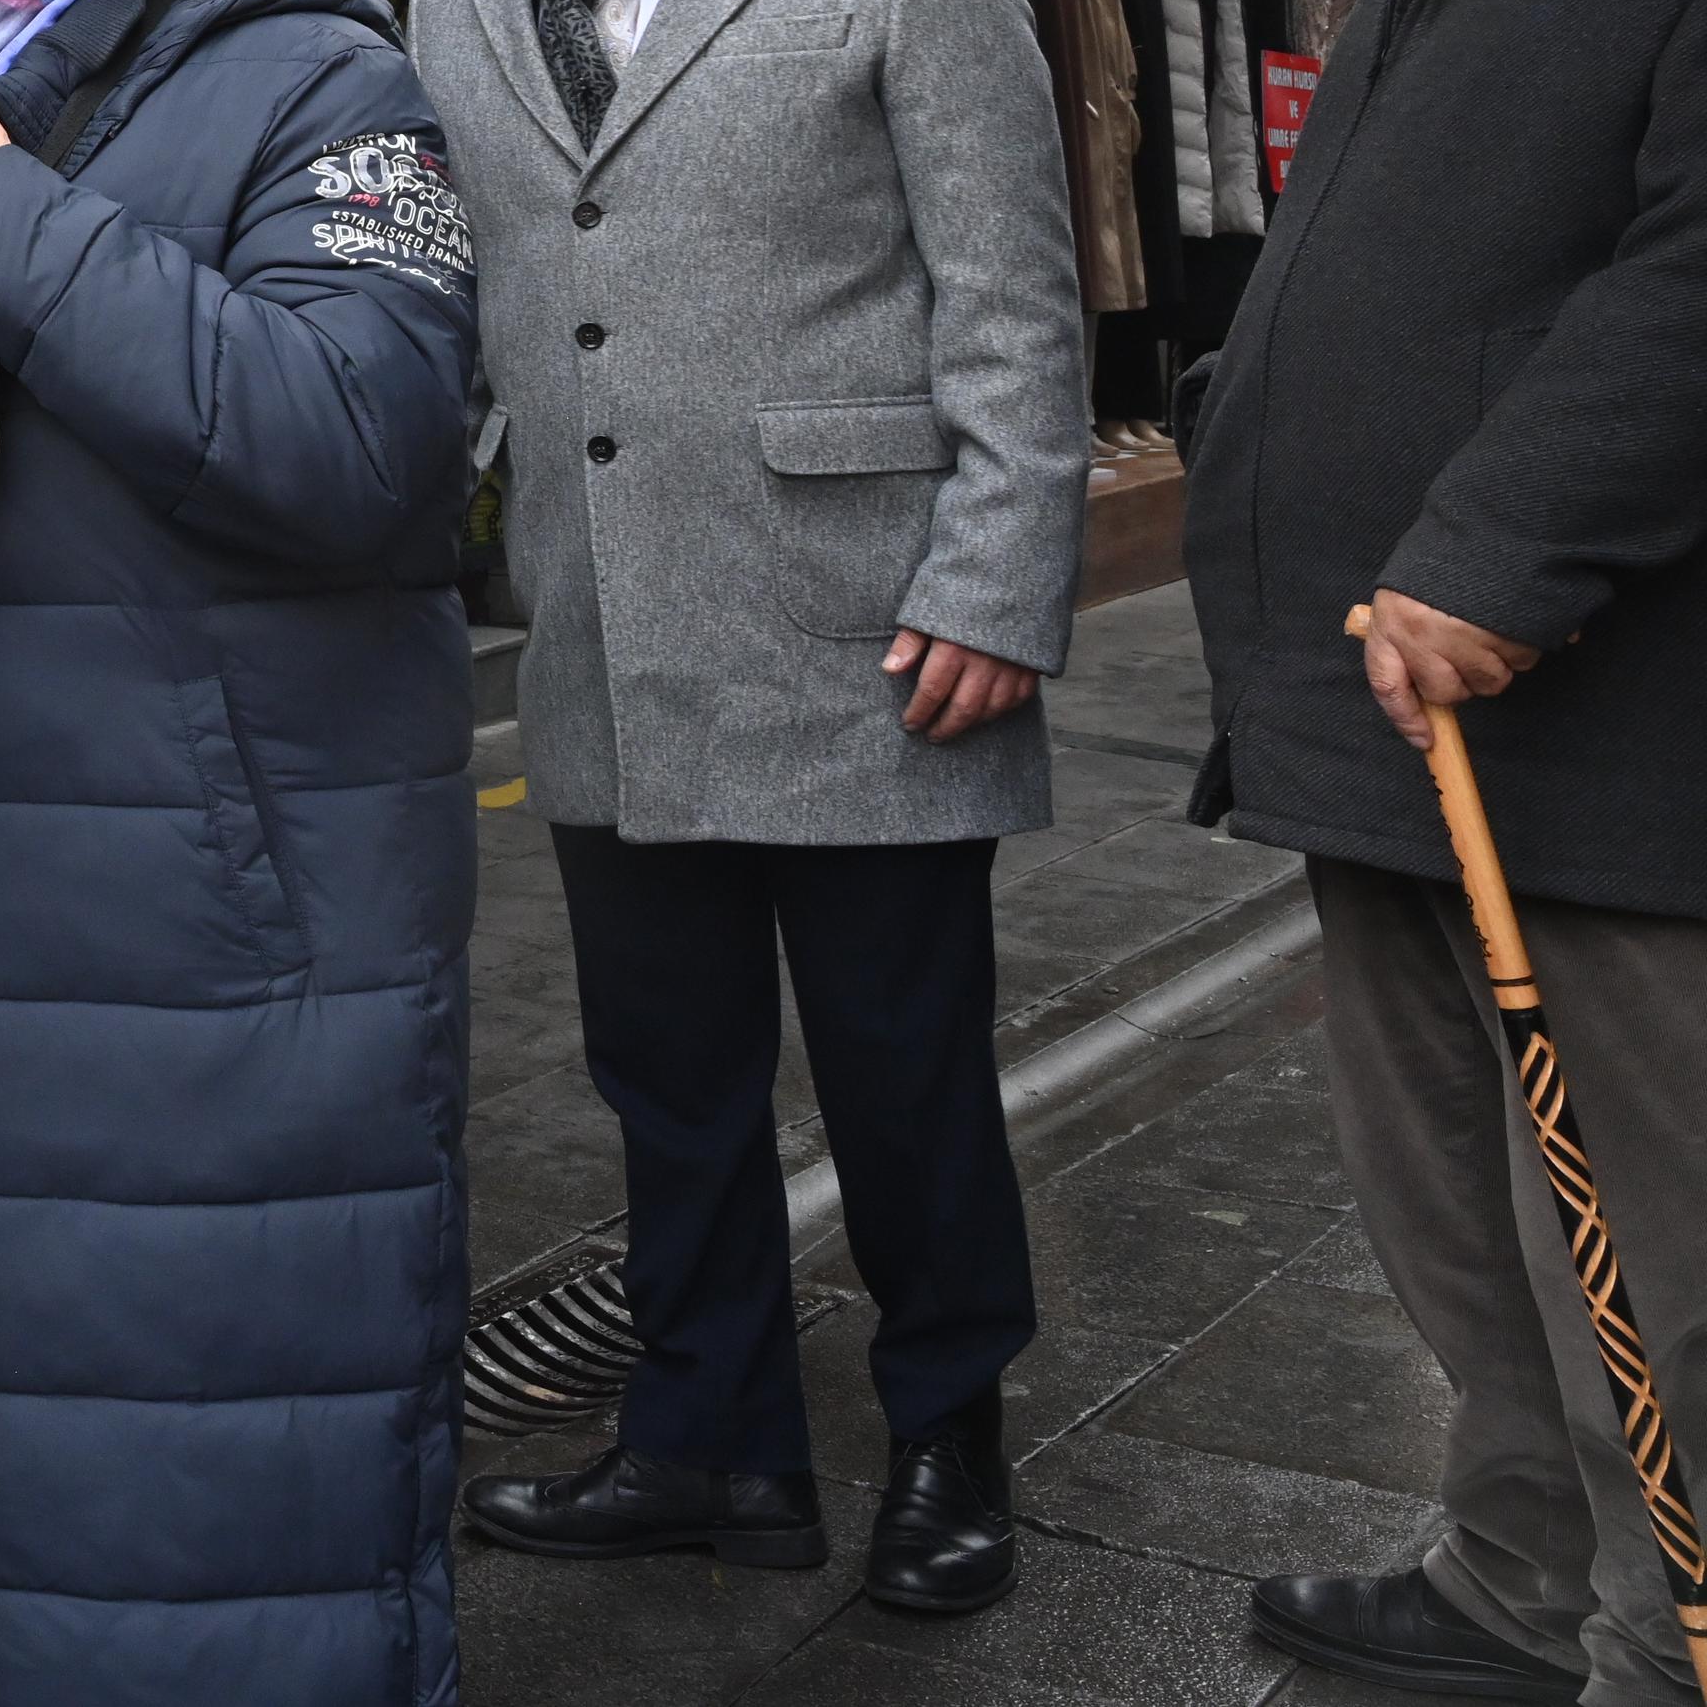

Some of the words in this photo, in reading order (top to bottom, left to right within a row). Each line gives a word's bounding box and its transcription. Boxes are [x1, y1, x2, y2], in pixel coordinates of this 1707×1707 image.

[348, 194, 381, 207] 1998
[394, 197, 474, 264] OCEAN
[333, 210, 424, 250] ESTABLISHED
[428, 243, 465, 272] BRAND
